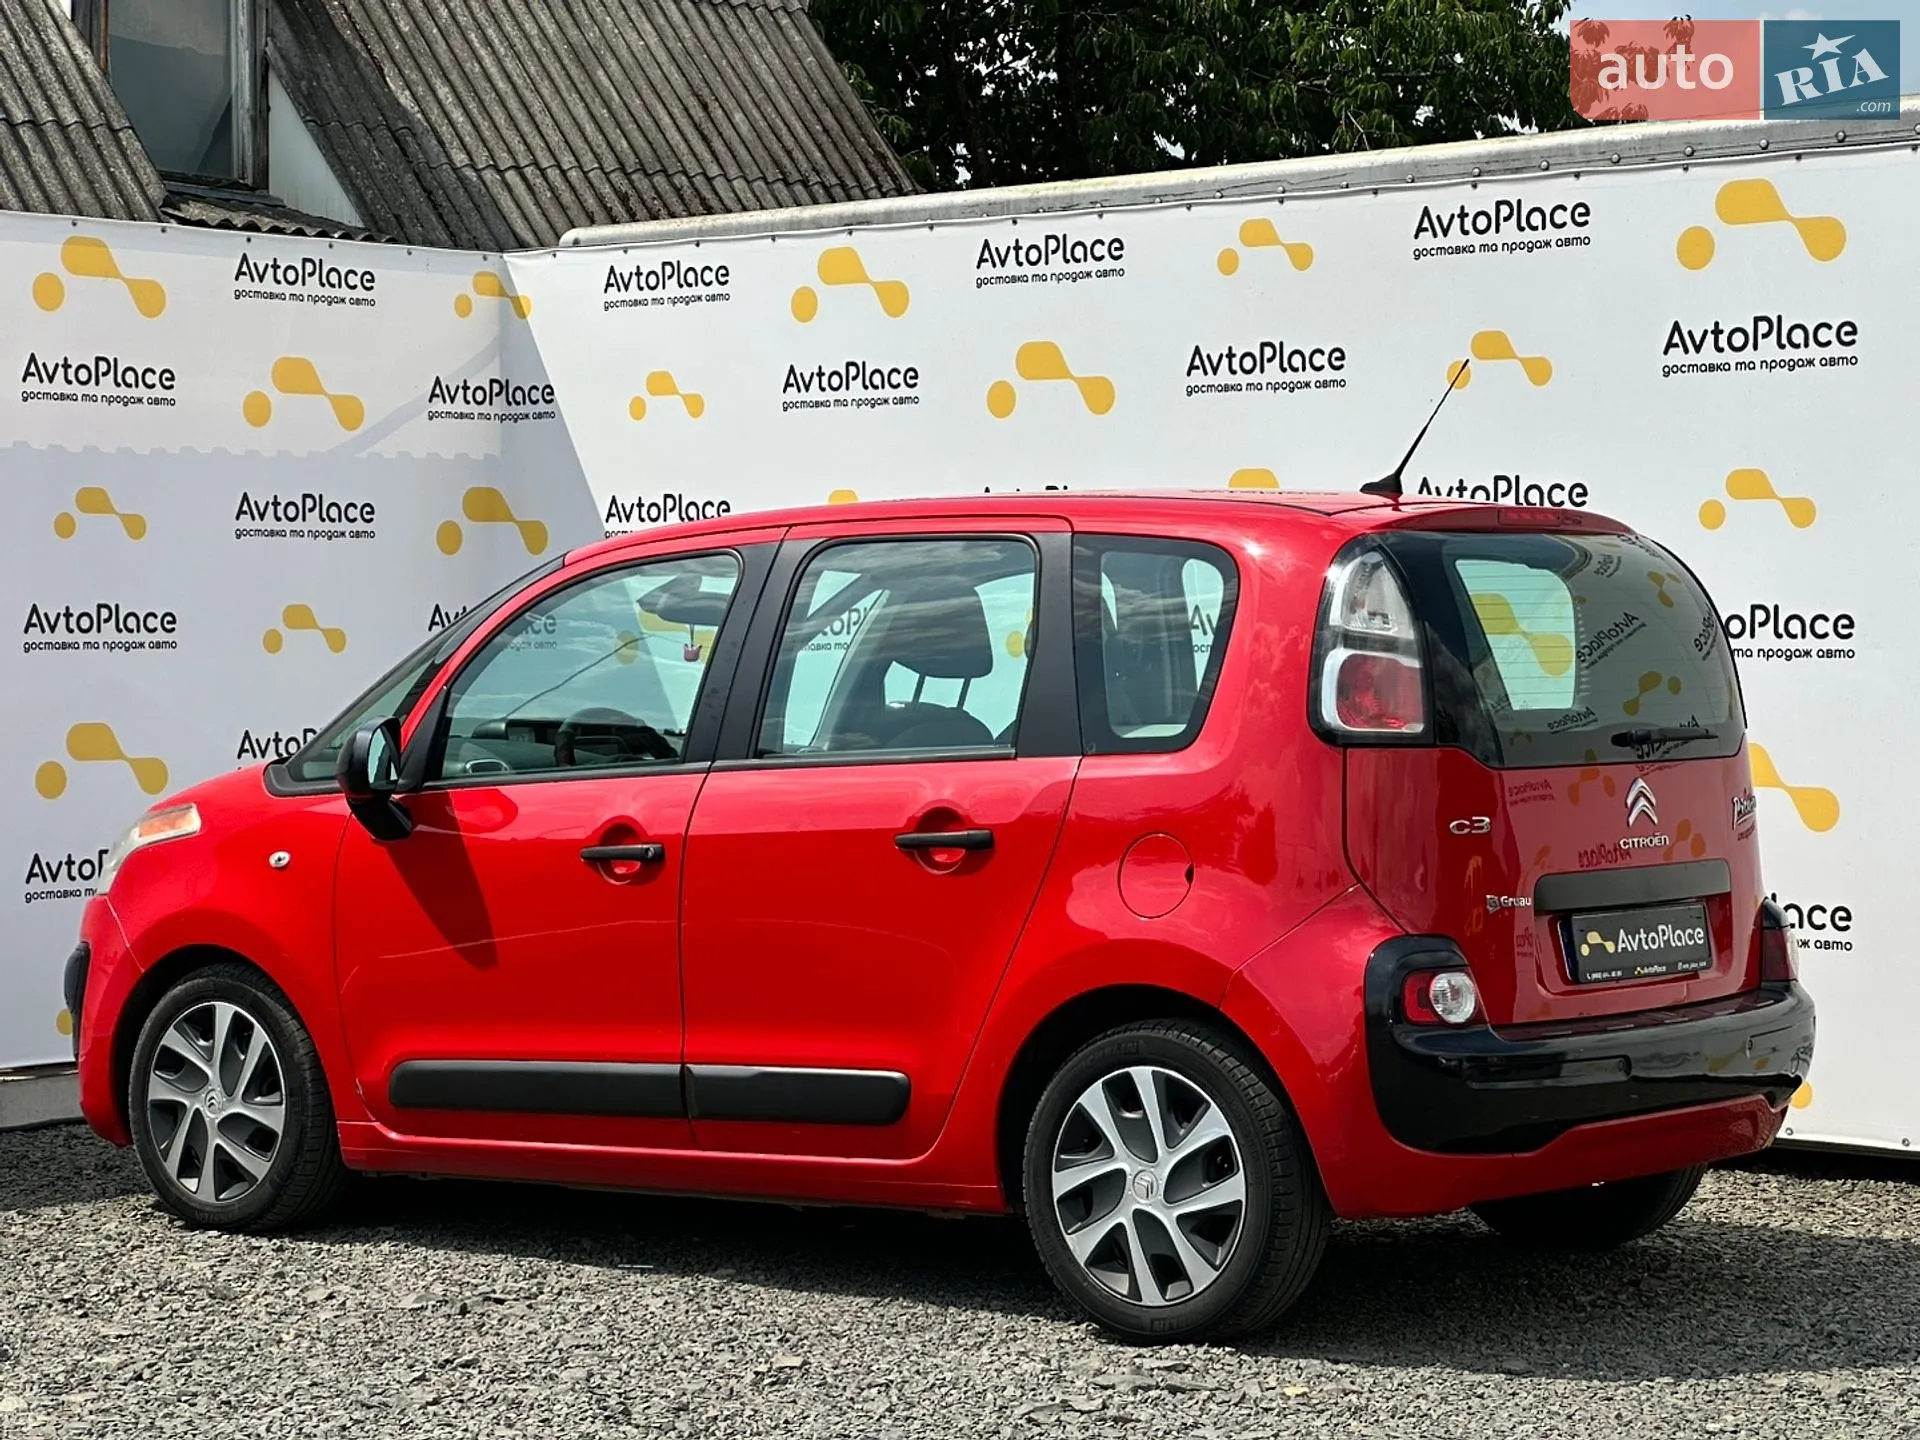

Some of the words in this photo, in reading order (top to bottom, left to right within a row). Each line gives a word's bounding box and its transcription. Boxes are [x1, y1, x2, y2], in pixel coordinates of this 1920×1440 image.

[1414, 199, 1590, 239] AvtoPlace
[976, 234, 1124, 270] AvtoPlace
[1413, 244, 1475, 261] доставка
[1479, 243, 1498, 253] та
[1502, 239, 1552, 254] продаж
[1555, 236, 1591, 247] авто
[235, 252, 375, 291] AvtoPlace
[604, 260, 729, 294] AvtoPlace
[976, 275, 1029, 289] доставка
[1031, 274, 1048, 282] та
[1050, 271, 1092, 283] продаж
[1095, 268, 1125, 278] авто
[1663, 315, 1858, 356] AvtoPlace
[22, 353, 175, 390] AvtoPlace
[1186, 341, 1346, 377] AvtoPlace
[1662, 362, 1731, 378] доставка
[1735, 361, 1756, 371] та
[1760, 358, 1815, 373] продаж
[1819, 356, 1858, 367] авто
[428, 376, 554, 407] AvtoPlace
[783, 361, 919, 394] AvtoPlace
[1186, 383, 1242, 397] доставка
[1246, 382, 1263, 391] та
[1266, 380, 1311, 393] продаж
[1315, 379, 1346, 389] авто
[22, 391, 78, 403] доставка
[81, 394, 98, 403] та
[101, 395, 144, 407] продаж
[147, 397, 175, 406] авто
[782, 400, 831, 412] доставка
[833, 399, 848, 407] та
[851, 397, 890, 409] продаж
[892, 396, 919, 405] авто
[235, 492, 375, 523] AvtoPlace
[24, 603, 176, 634] AvtoPlace
[1724, 603, 1856, 640] oPlace
[23, 642, 80, 653] доставка
[83, 642, 99, 650] та
[103, 641, 145, 652] продаж
[148, 641, 177, 649] авто
[1757, 648, 1813, 661] продаж
[1816, 649, 1856, 658] авто
[1450, 816, 1491, 835] C3
[25, 888, 81, 903] доставка
[1617, 924, 1704, 953] AvtoPlace
[1814, 939, 1853, 951] авто
